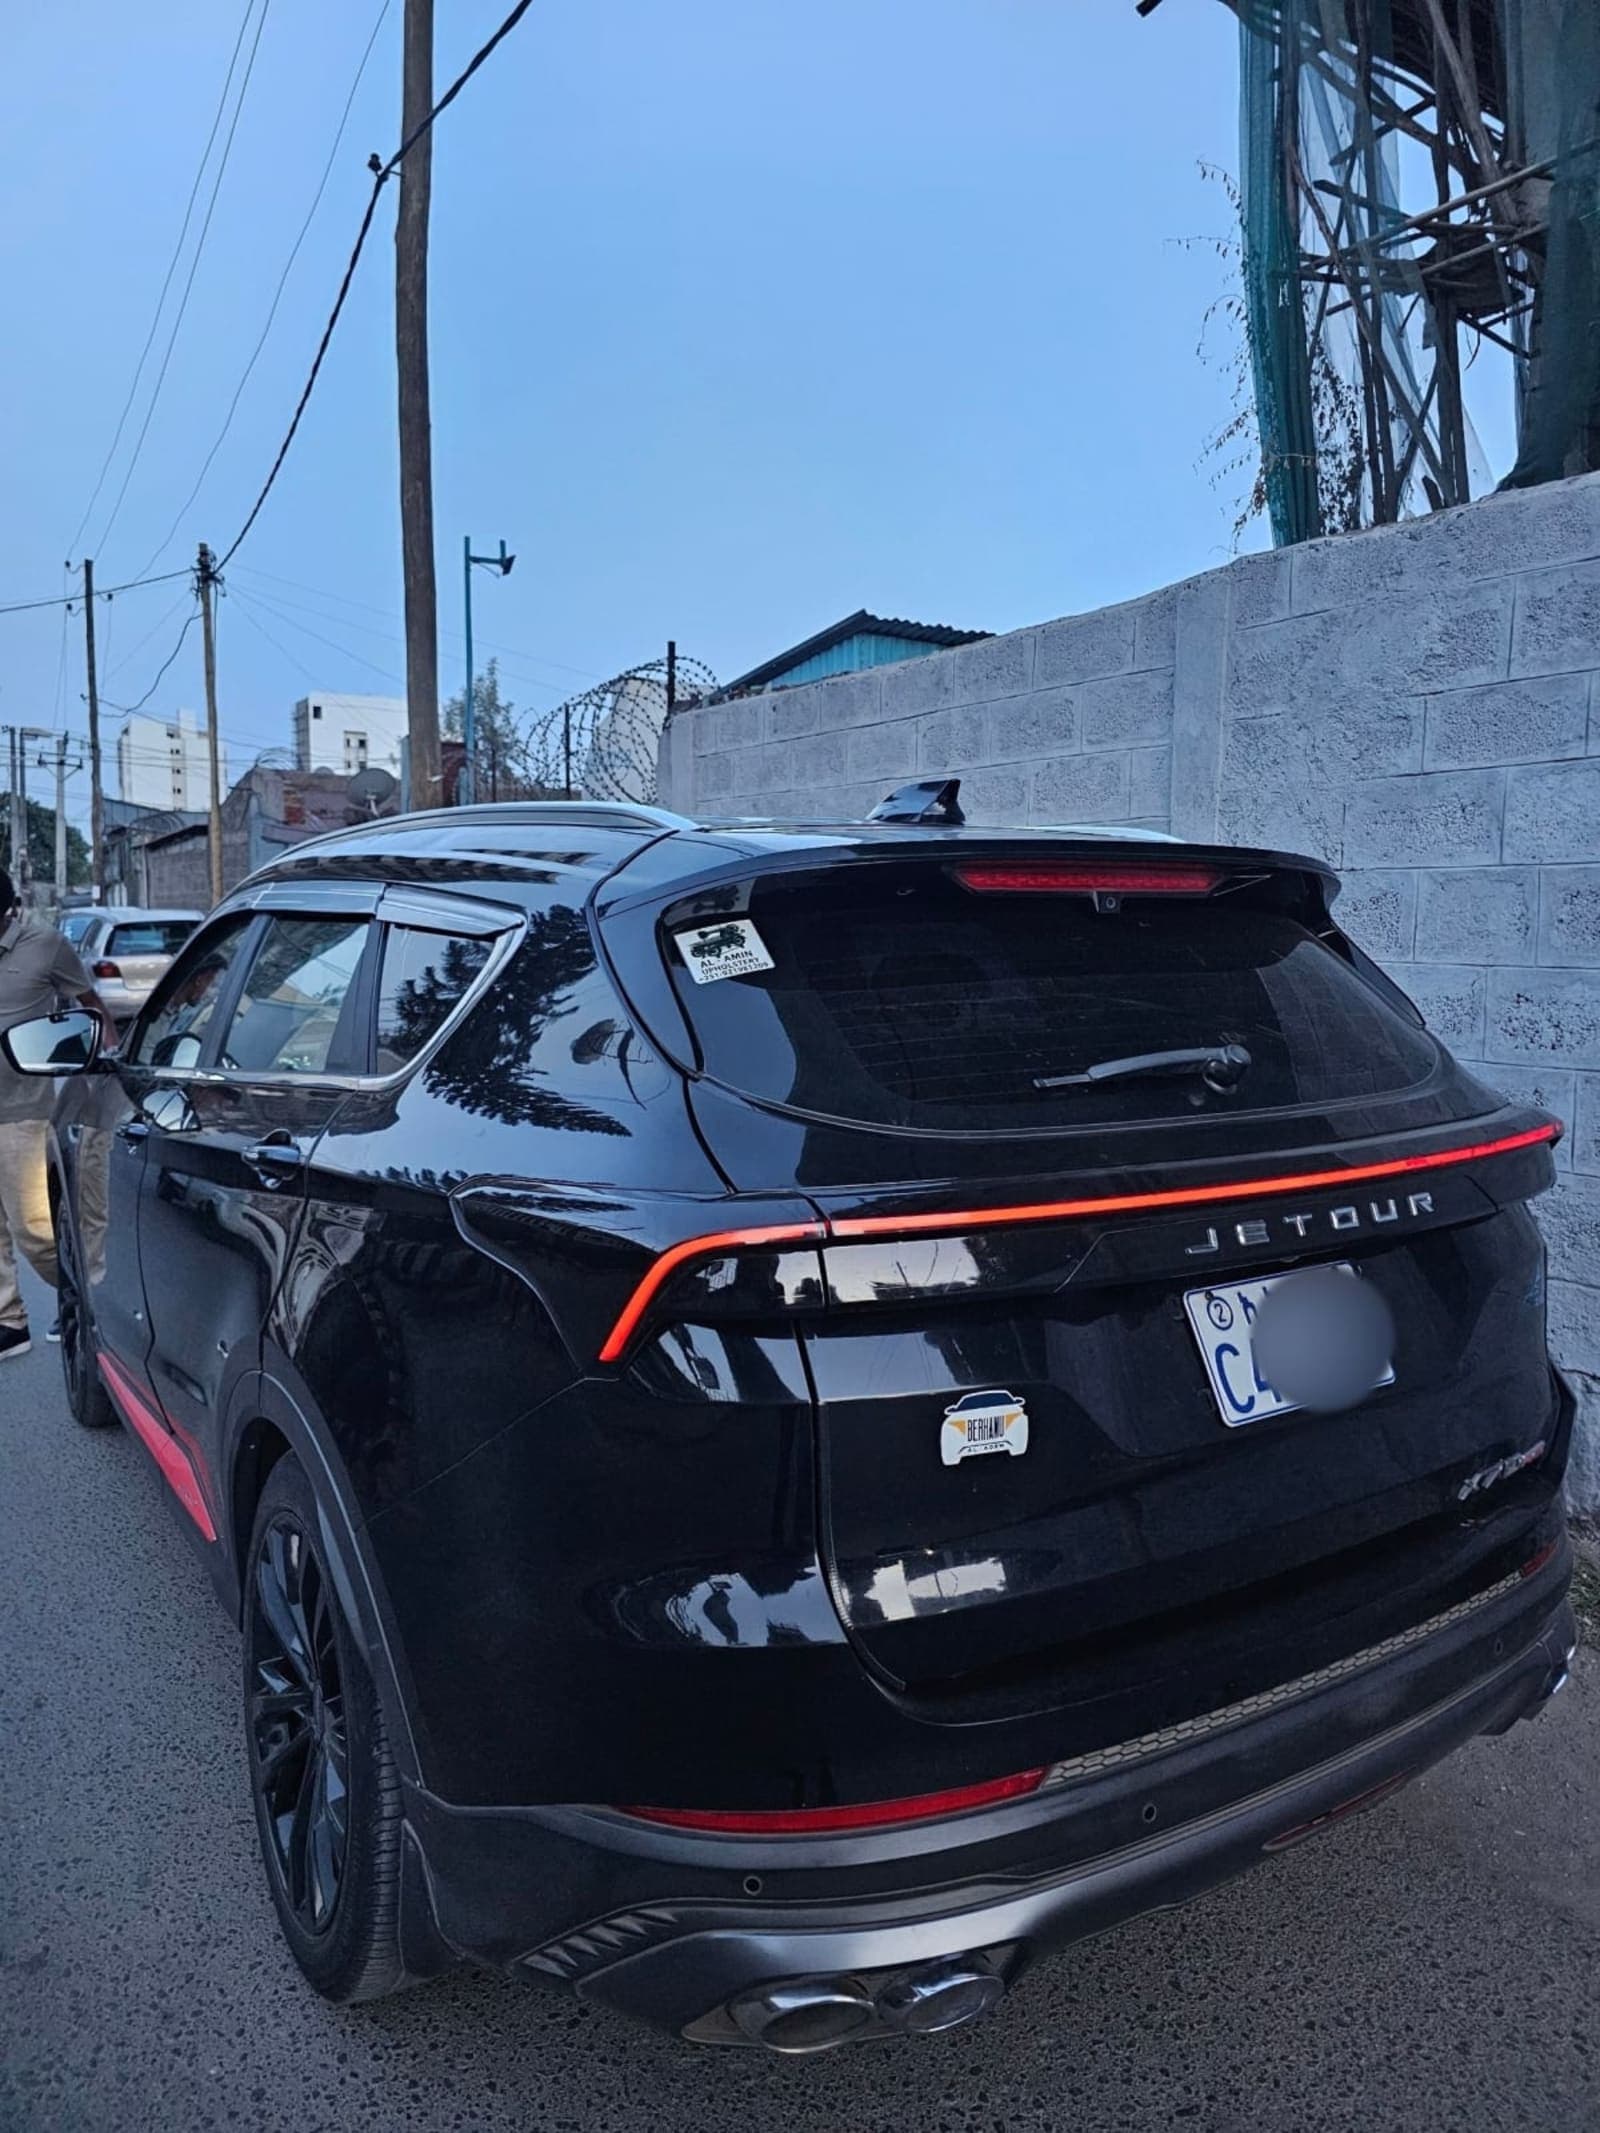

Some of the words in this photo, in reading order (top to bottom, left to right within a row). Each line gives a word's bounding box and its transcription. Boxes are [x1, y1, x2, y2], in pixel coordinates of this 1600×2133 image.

[701, 959, 715, 968] AL
[724, 951, 753, 962] AMIN
[701, 957, 760, 976] UPHOLSTERY
[1184, 1191, 1435, 1255] JETOUR
